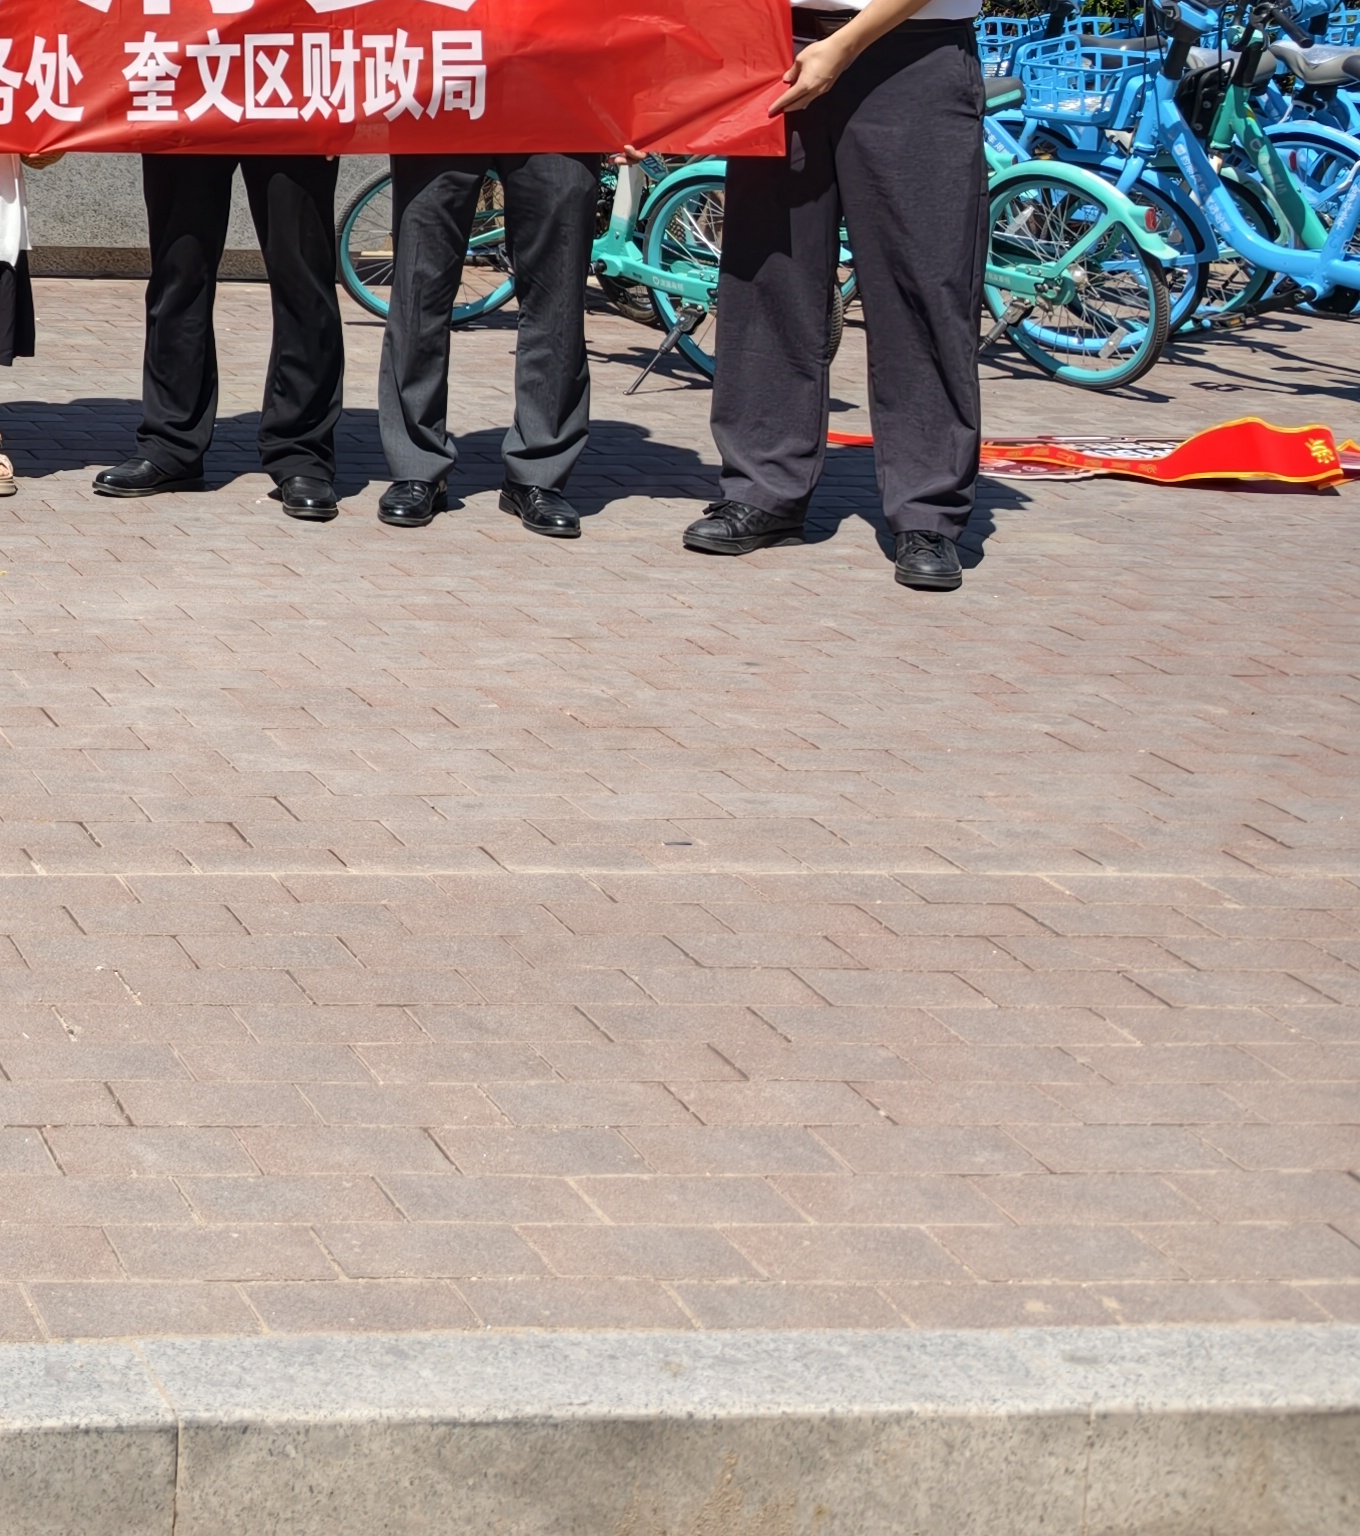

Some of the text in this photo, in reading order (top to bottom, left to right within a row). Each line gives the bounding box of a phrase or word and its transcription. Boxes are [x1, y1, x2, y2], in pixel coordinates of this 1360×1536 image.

[121, 27, 488, 125] 奎文区财政局
